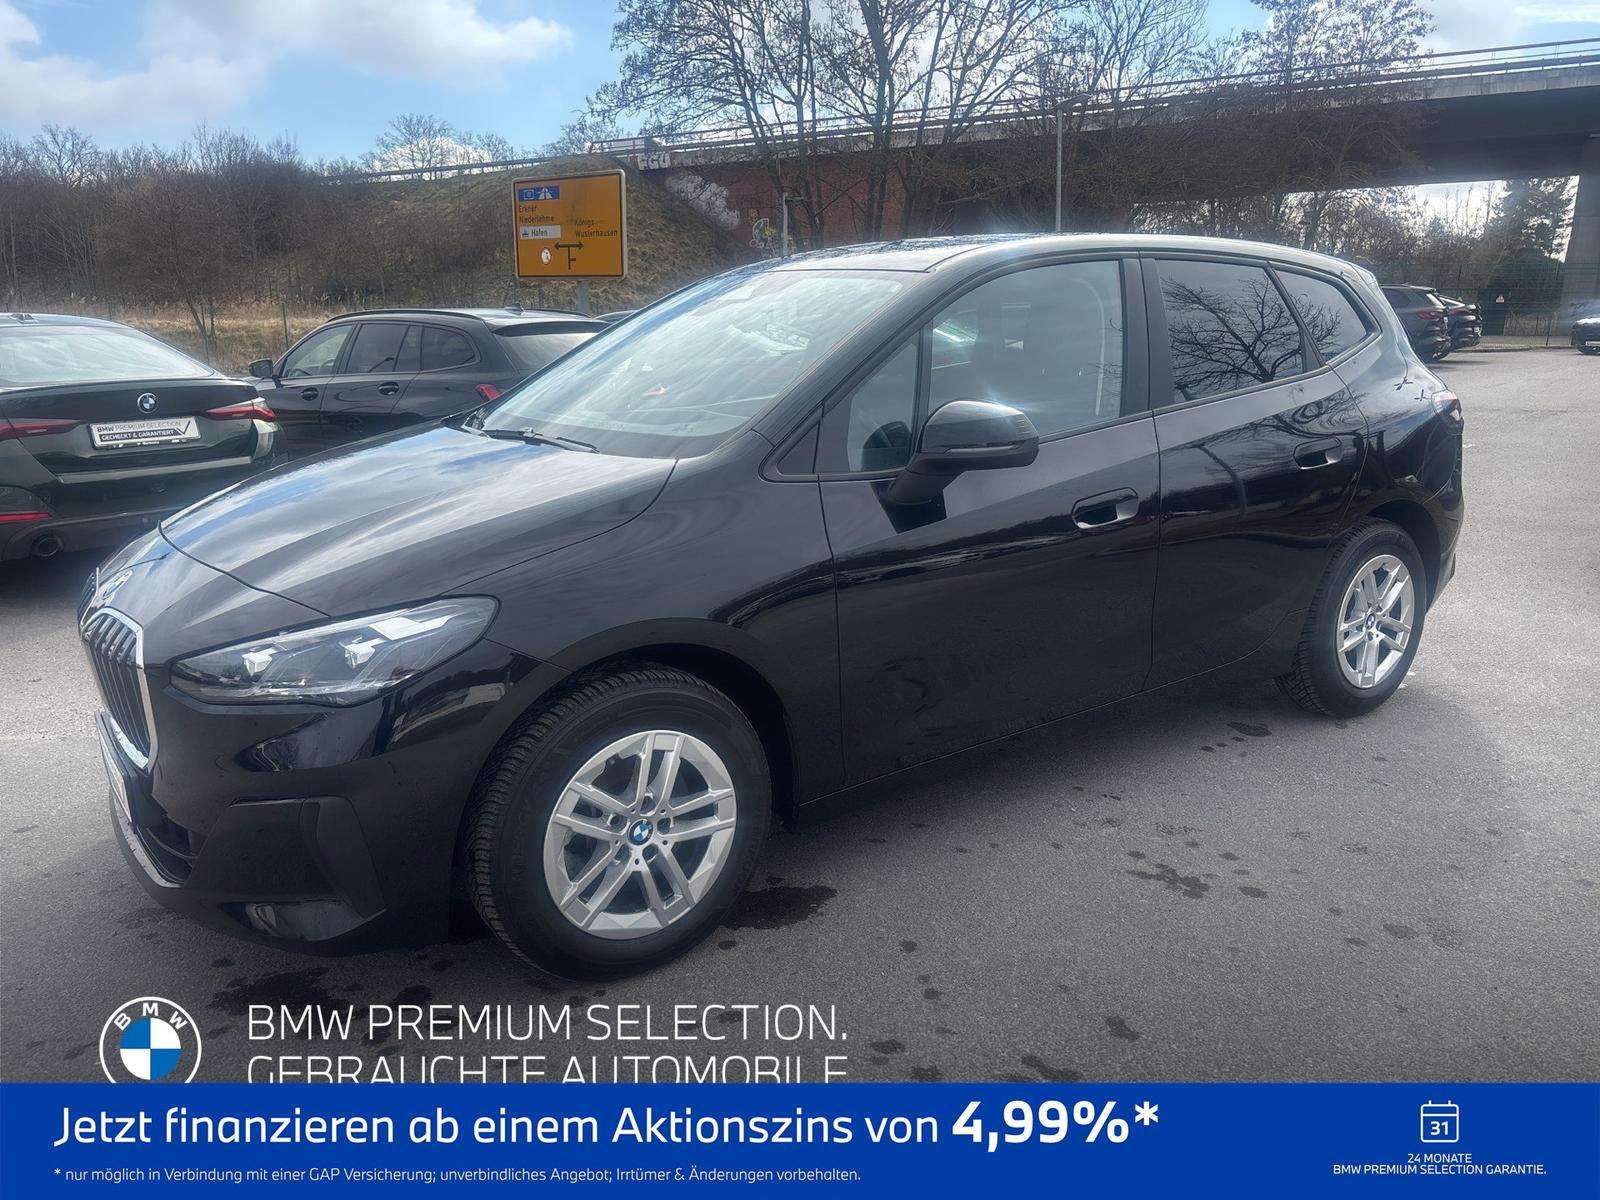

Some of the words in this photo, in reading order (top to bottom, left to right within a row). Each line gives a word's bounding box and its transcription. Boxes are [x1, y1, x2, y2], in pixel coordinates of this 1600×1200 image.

[531, 228, 548, 237] Hafen
[115, 423, 146, 431] PREMIUM
[146, 420, 182, 429] SELECTION
[101, 432, 132, 441] GECHECKT
[138, 429, 174, 438] GARANTIERT
